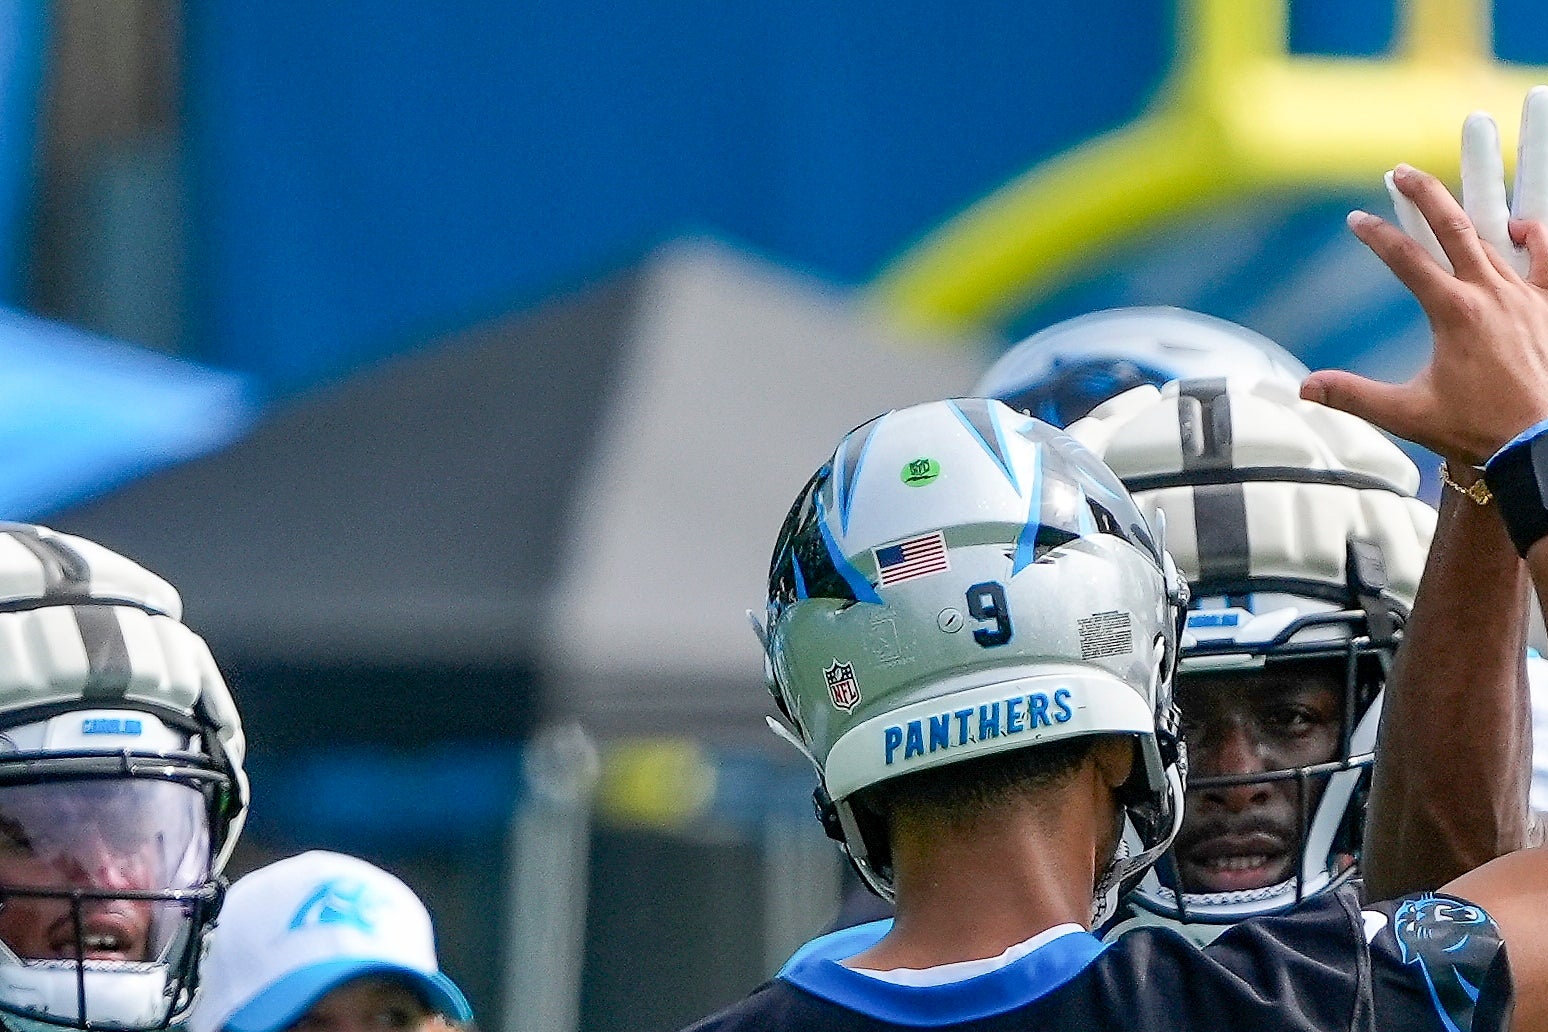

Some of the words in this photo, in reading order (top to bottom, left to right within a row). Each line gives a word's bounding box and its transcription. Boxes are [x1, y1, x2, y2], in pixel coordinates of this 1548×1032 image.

[965, 581, 1013, 649] 9
[832, 681, 857, 704] NFL
[884, 688, 1073, 765] PANTHERS
